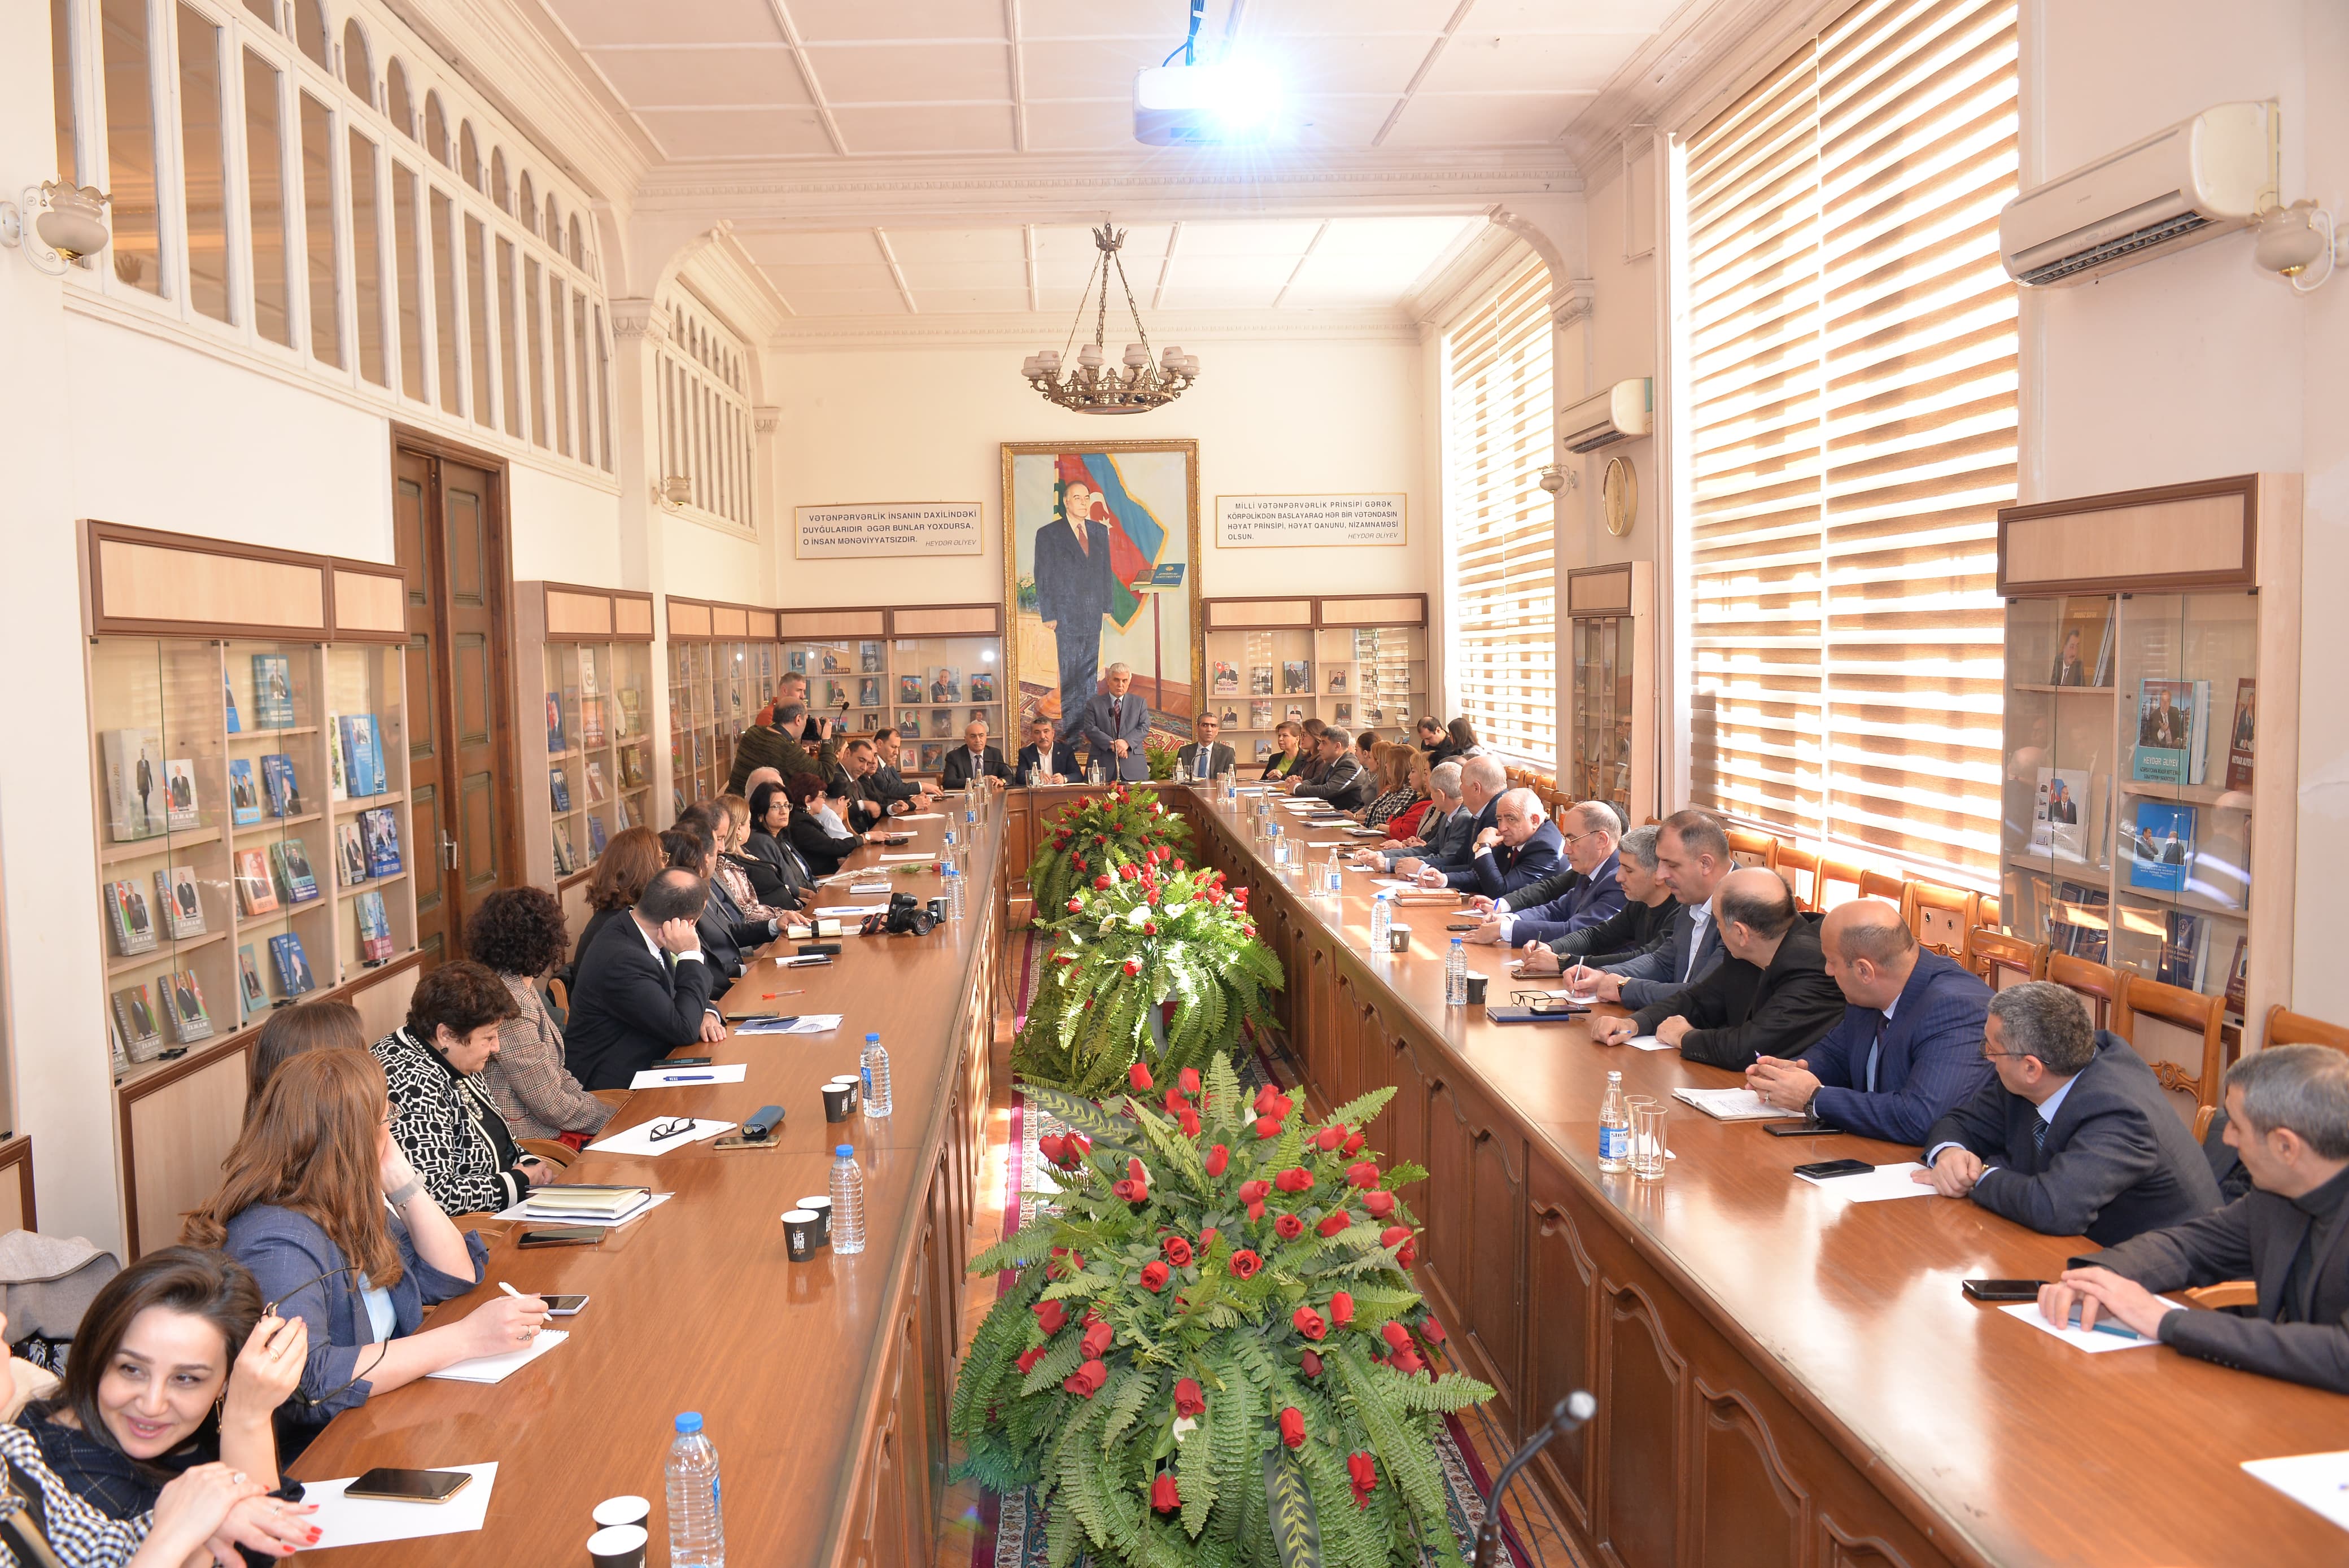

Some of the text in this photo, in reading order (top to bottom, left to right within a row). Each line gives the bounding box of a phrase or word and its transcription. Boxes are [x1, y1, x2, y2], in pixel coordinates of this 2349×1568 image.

[1258, 500, 1327, 509] VƏTƏNPƏRVƏRLİK
[809, 509, 976, 521] VƏTƏNPƏRVƏRLİK İNSANIN DAXİLİNDƏKİ
[803, 525, 862, 534] DUYĞULARIDIR
[838, 535, 918, 544] MƏNƏVİYYATSIZDIR.
[2143, 757, 2162, 765] HEYDƏR
[132, 934, 152, 944] İLHAM
[187, 1021, 208, 1031] İLHAM
